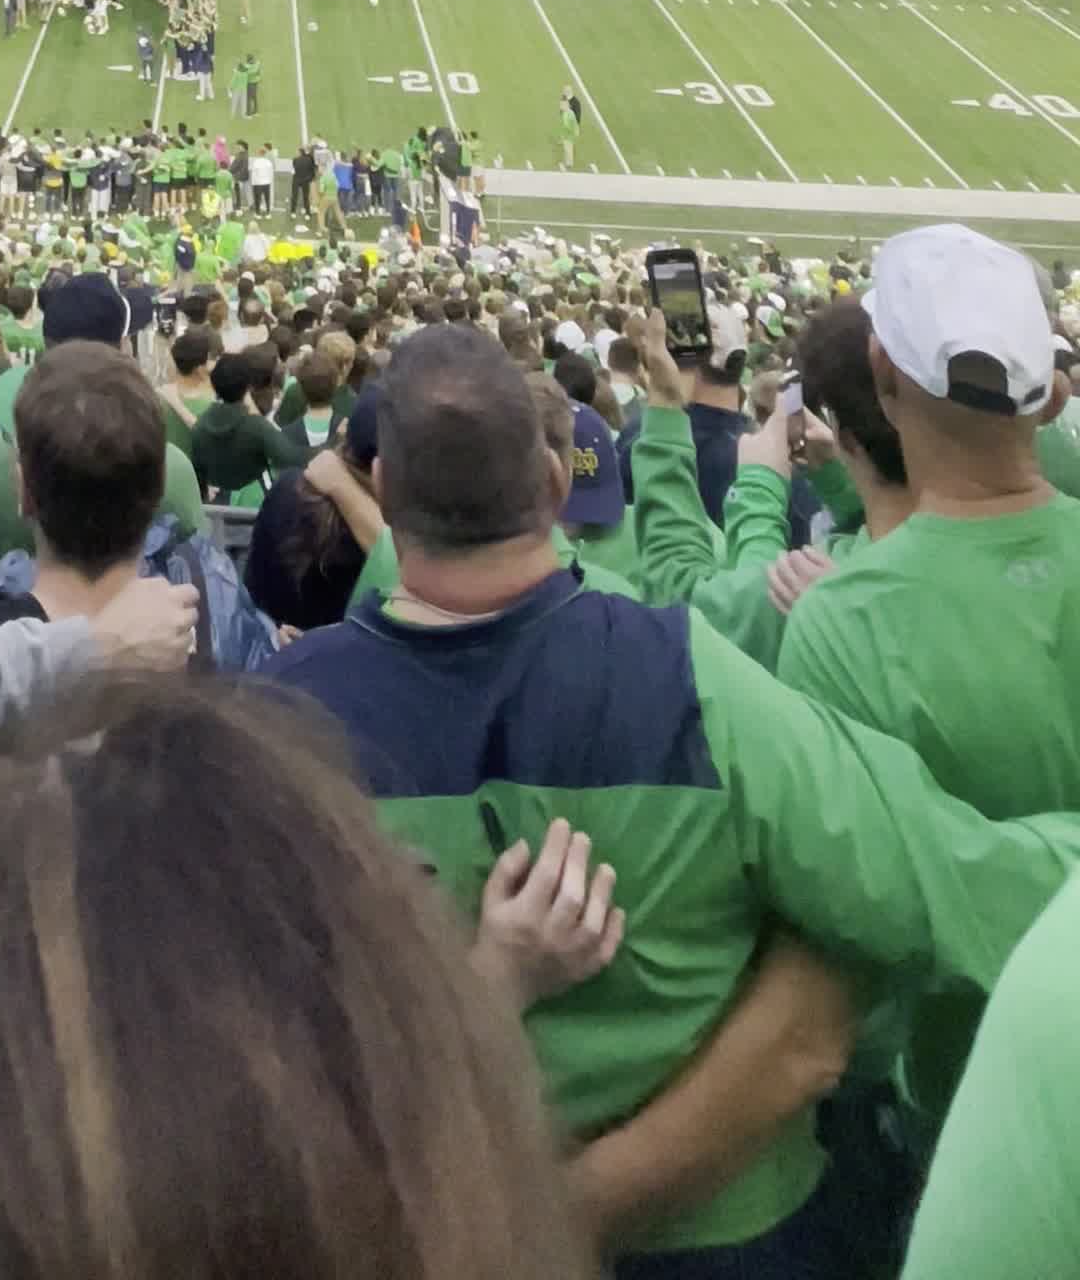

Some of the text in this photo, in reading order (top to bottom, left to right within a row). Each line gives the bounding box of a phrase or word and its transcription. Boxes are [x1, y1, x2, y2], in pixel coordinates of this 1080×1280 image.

[399, 70, 480, 94] 20
[684, 82, 775, 106] 30
[988, 93, 1080, 118] 40
